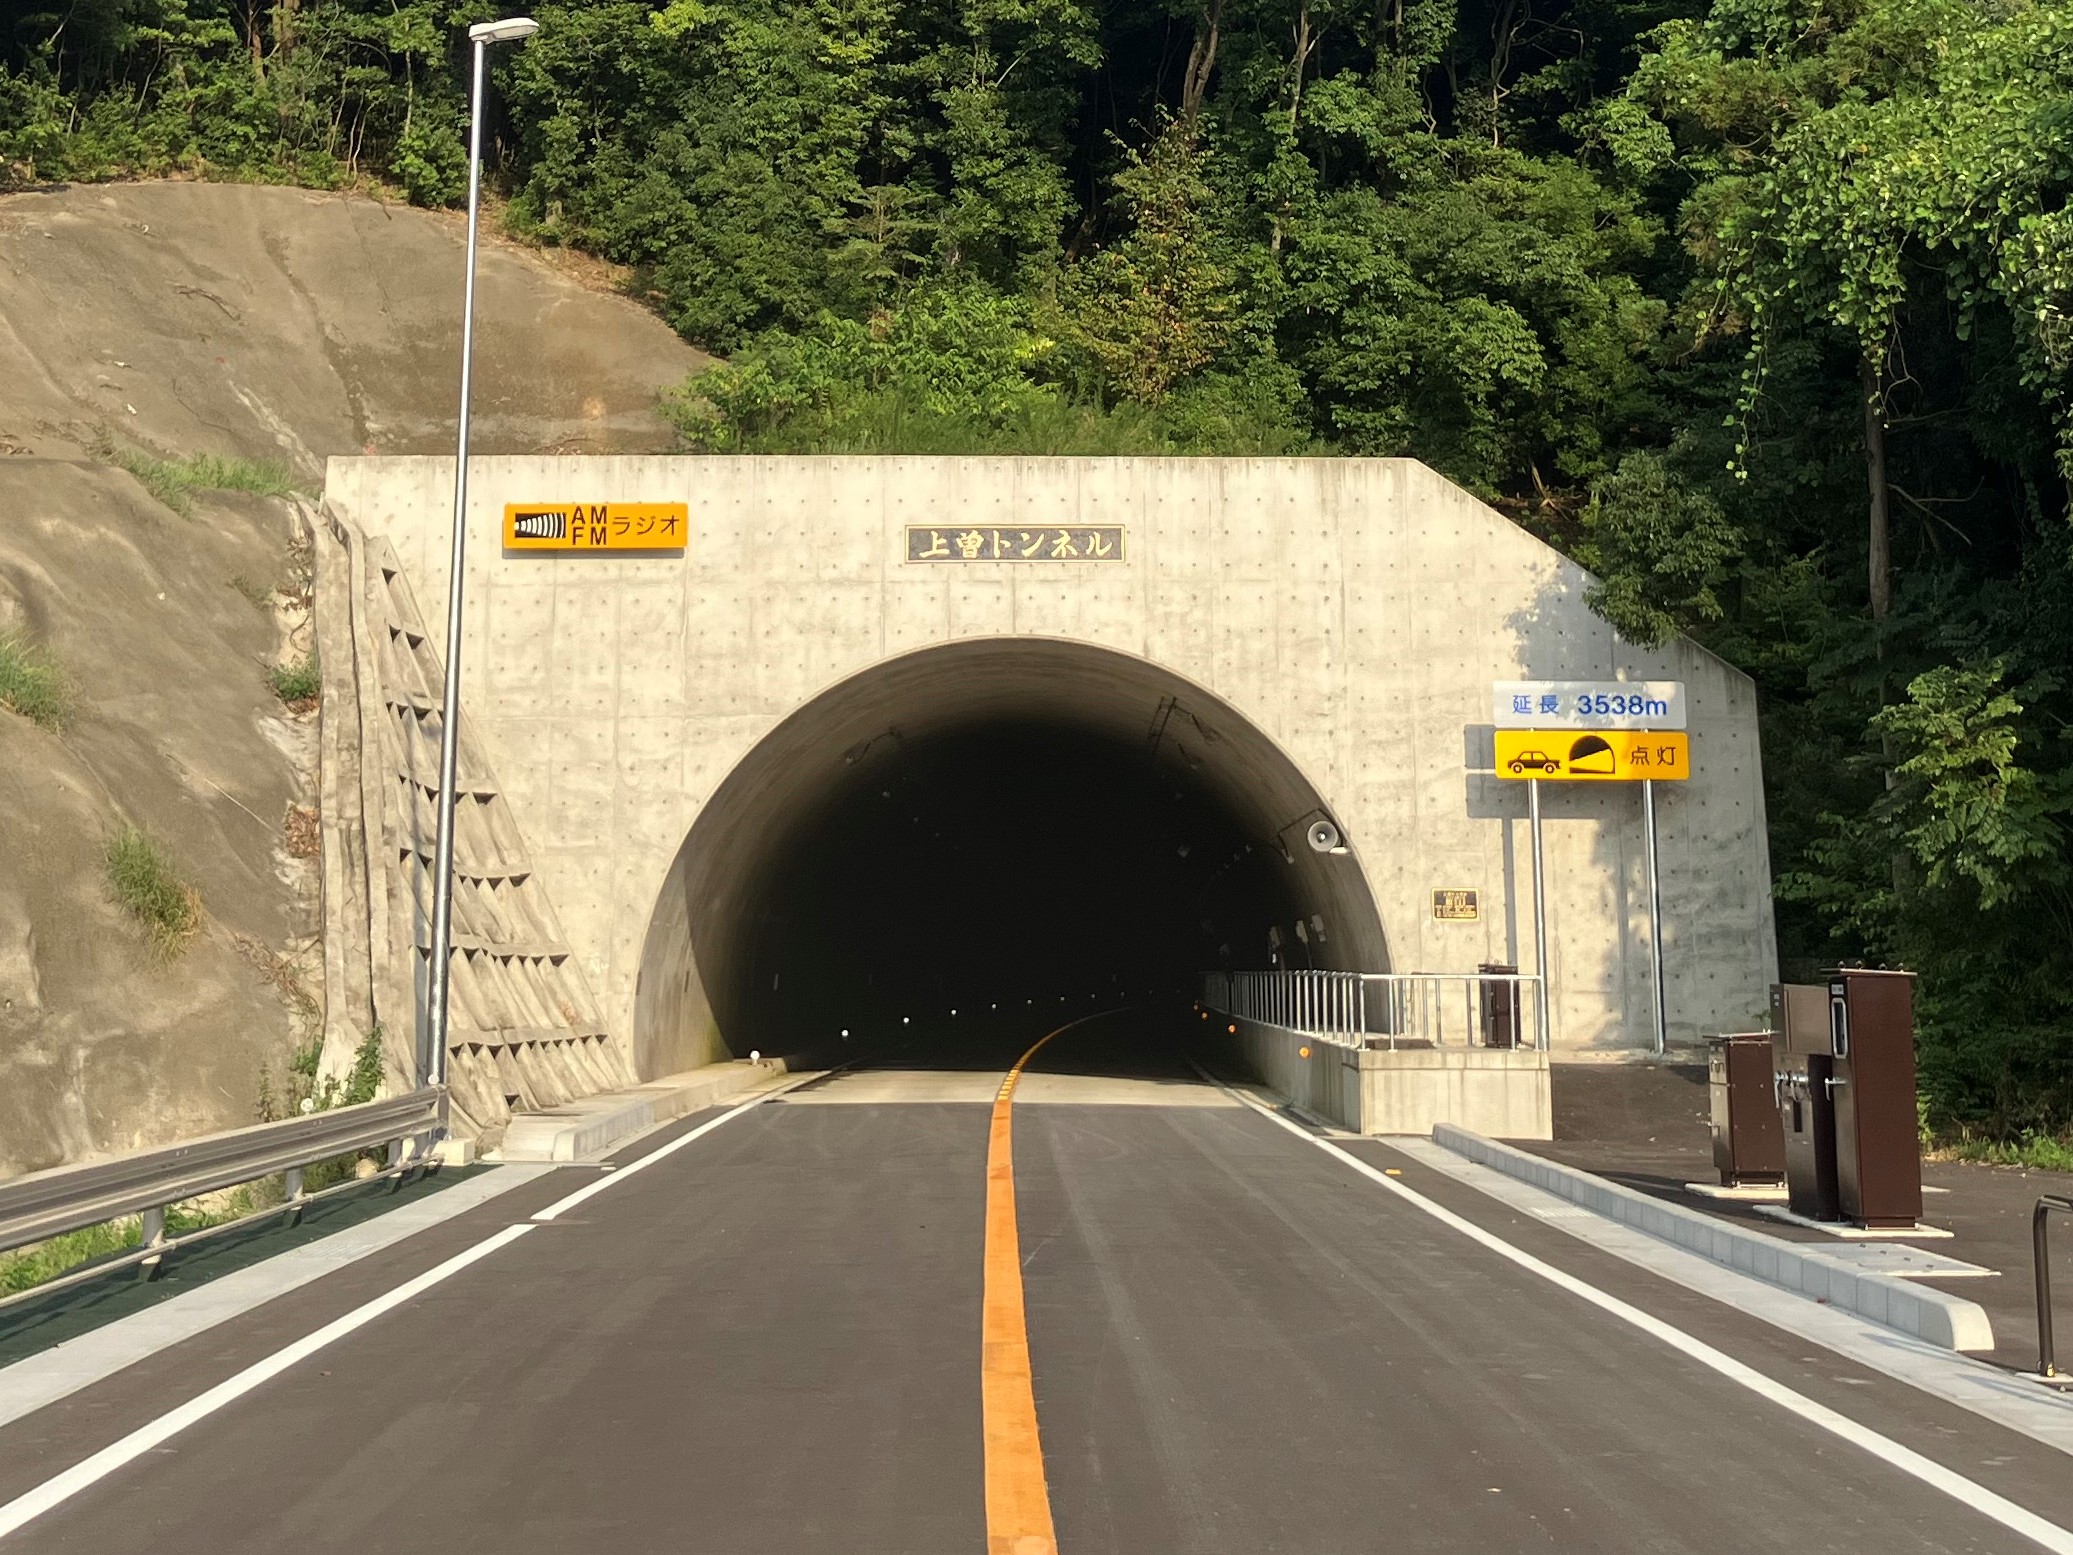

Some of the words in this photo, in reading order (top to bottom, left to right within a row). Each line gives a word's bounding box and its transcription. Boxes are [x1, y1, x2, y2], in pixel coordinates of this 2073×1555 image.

[571, 505, 608, 525] AM
[612, 514, 680, 536] ラジオ
[572, 526, 607, 545] FM
[919, 529, 1113, 558] 上曽トンネル
[1512, 694, 1560, 715] 延長
[1577, 694, 1668, 716] 3538m
[1629, 745, 1676, 766] 点灯
